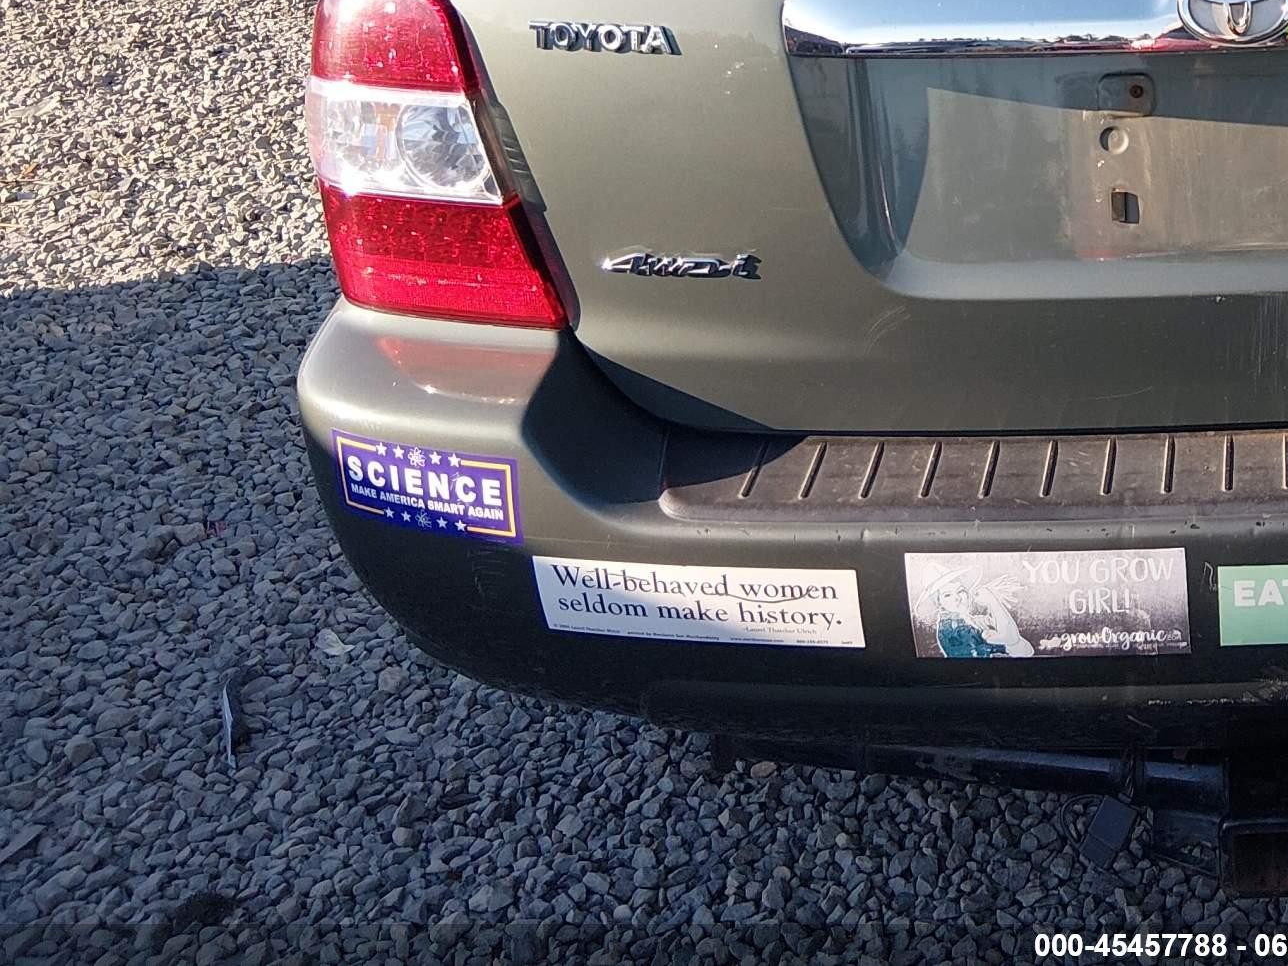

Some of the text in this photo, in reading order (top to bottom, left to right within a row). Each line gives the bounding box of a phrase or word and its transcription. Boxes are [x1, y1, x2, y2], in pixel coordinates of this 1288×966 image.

[528, 20, 682, 55] TOYOTA
[347, 455, 502, 507] SCIENCE
[351, 483, 504, 521] MAKE AMERICA SMART AGAIN
[551, 564, 838, 600] Well-behaved women
[1022, 557, 1173, 584] YOU GROW
[558, 593, 842, 631] seldom make history.
[1069, 588, 1130, 615] GIRL!
